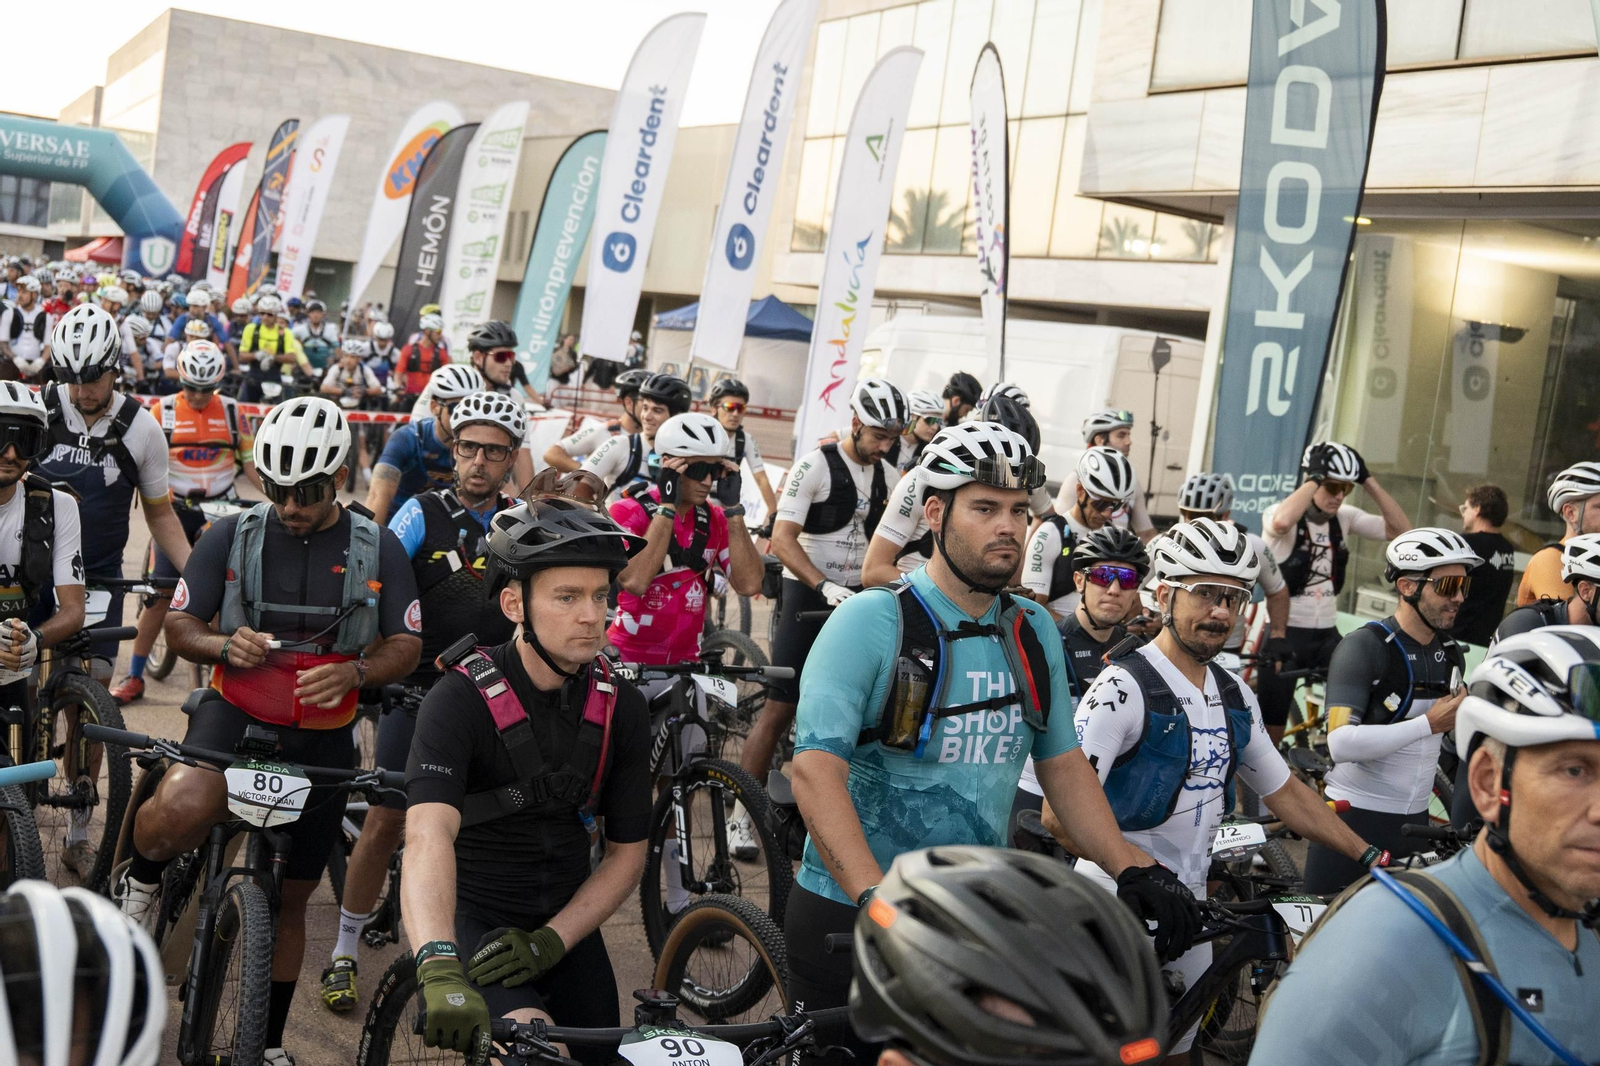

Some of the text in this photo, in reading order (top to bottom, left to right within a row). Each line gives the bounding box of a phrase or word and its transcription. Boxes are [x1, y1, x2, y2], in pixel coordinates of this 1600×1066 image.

[744, 61, 788, 216] Cleardent
[621, 84, 667, 224] Cleardent
[415, 195, 450, 287] HEMÓN
[819, 231, 873, 413] Andalucía
[497, 558, 519, 577] SMITH
[1492, 659, 1549, 699] MET
[944, 703, 1024, 735] SHOP
[938, 735, 1014, 765] BIKE
[420, 763, 453, 776] TREK
[253, 772, 284, 794] 80
[708, 770, 742, 794] MAXXIS
[1215, 834, 1252, 847] FERNANDO
[1293, 904, 1314, 924] 77
[472, 941, 504, 963] HESTRA
[659, 1037, 706, 1059] 90
